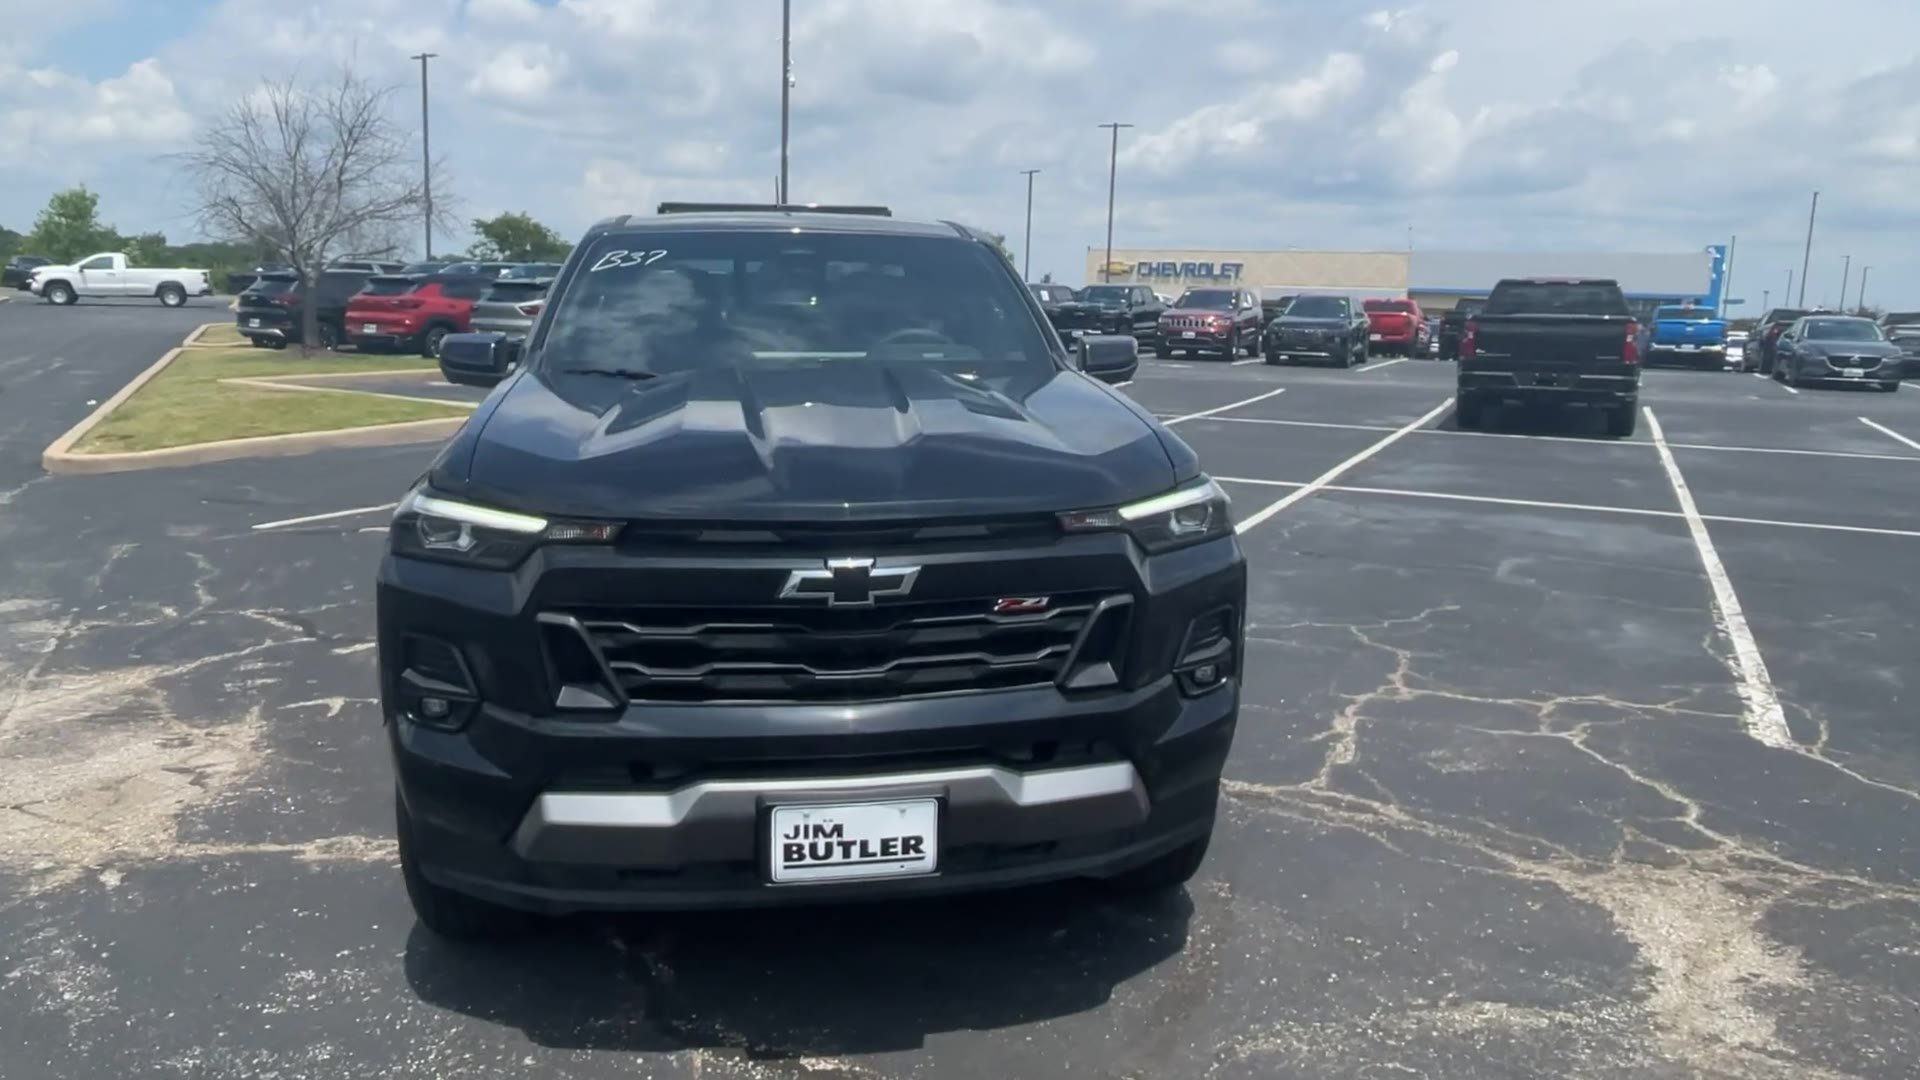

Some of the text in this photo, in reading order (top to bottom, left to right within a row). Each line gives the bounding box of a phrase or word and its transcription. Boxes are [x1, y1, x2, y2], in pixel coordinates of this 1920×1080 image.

[590, 250, 668, 272] B37
[1137, 261, 1244, 280] CHEVROLET
[783, 823, 844, 840] JIM
[783, 835, 926, 863] BUTLER
